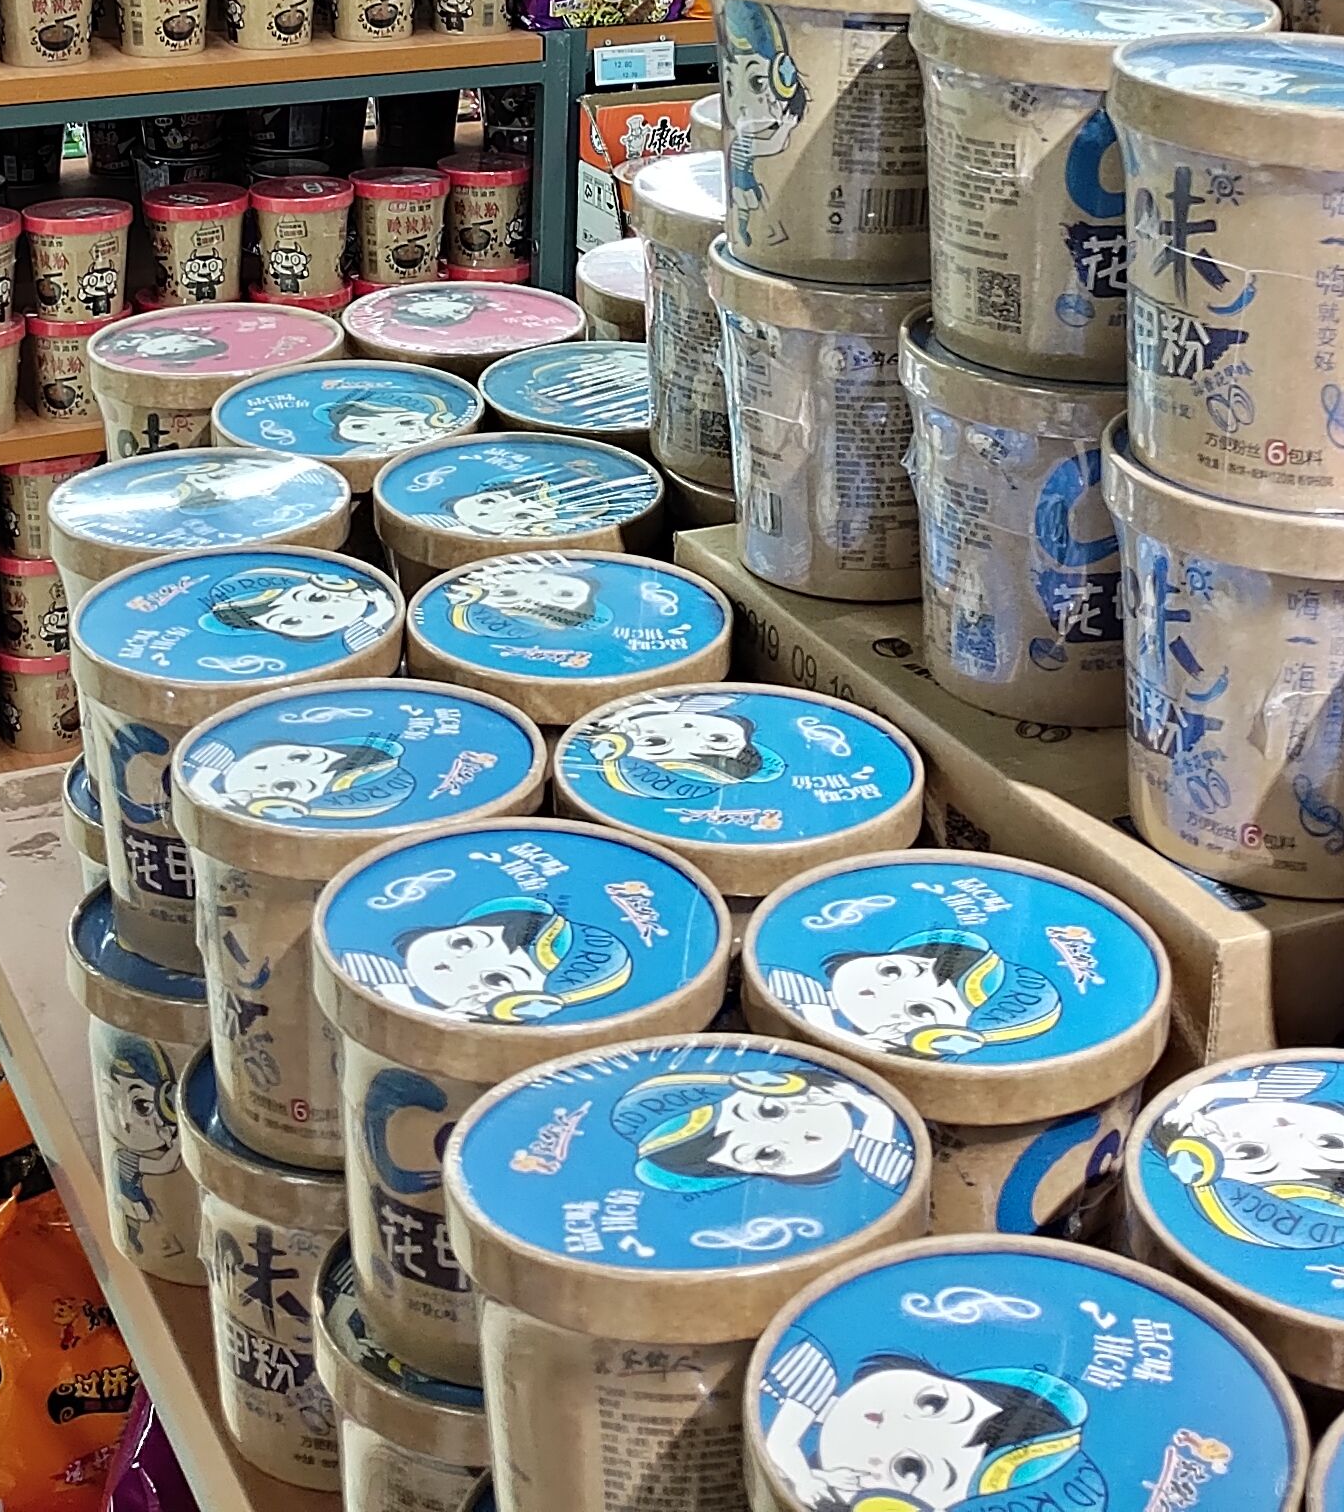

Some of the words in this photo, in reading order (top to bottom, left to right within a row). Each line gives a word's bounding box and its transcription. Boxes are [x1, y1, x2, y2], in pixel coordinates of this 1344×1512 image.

[648, 119, 691, 155] 康师
[1081, 235, 1129, 291] 花
[1205, 431, 1324, 469] 方便粉丝6包料
[1229, 1188, 1303, 1238] ROCK
[75, 1368, 136, 1399] 过桥
